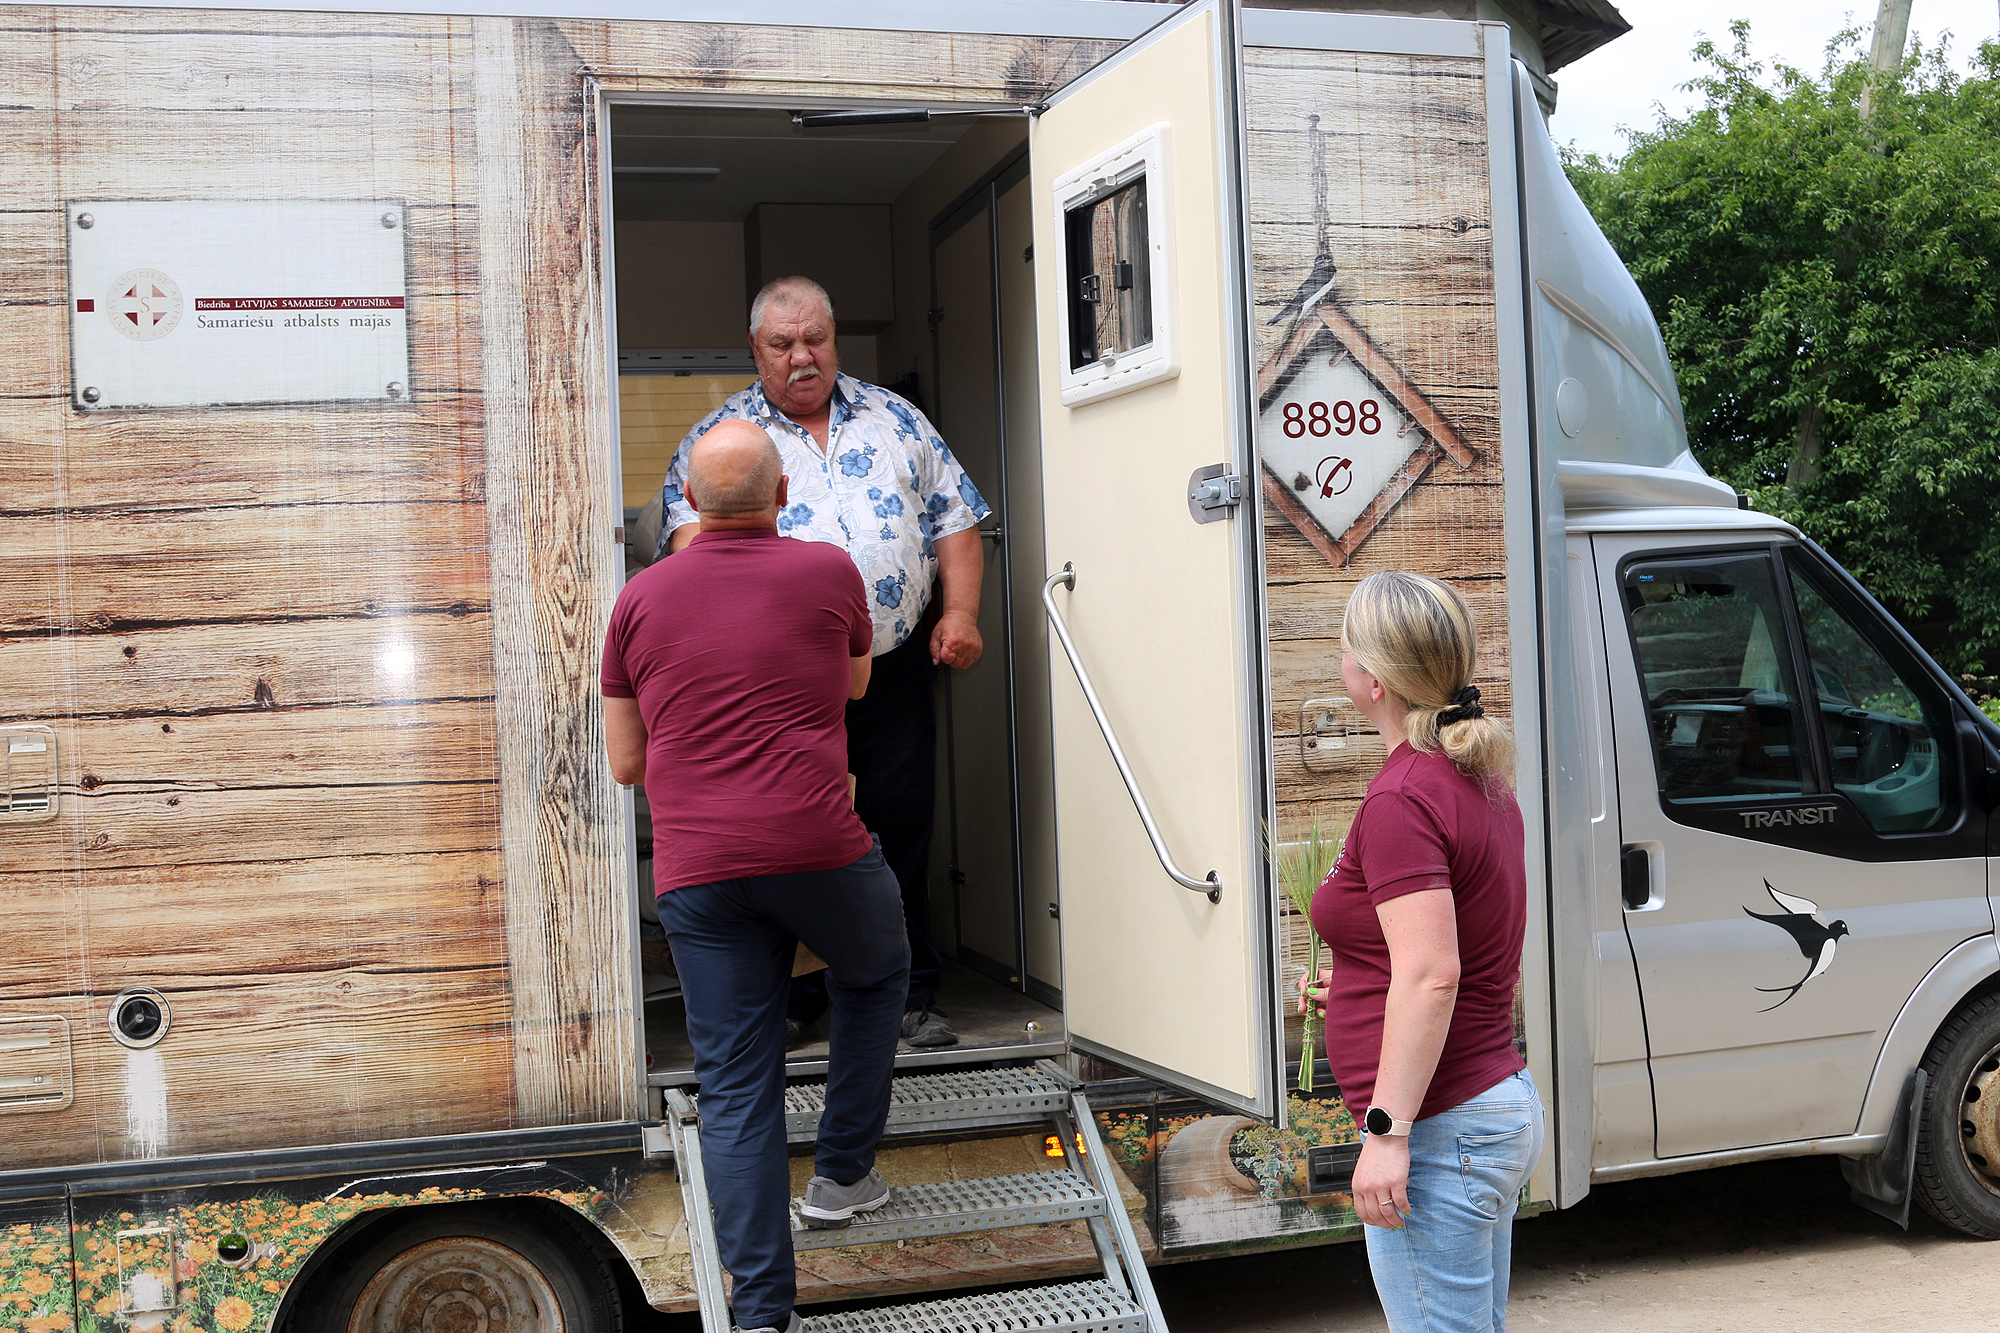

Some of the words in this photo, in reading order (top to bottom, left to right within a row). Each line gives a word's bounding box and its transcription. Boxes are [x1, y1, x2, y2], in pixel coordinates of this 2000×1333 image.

[235, 299, 278, 309] LATVIJAS
[282, 298, 337, 308] SAMARIEŠU
[341, 298, 391, 307] APVIENĪBA
[197, 314, 274, 329] Samariešu
[284, 313, 340, 328] atbalsts
[350, 313, 391, 331] mājās
[1283, 400, 1382, 438] 8898
[1739, 807, 1838, 829] TRANSIT
